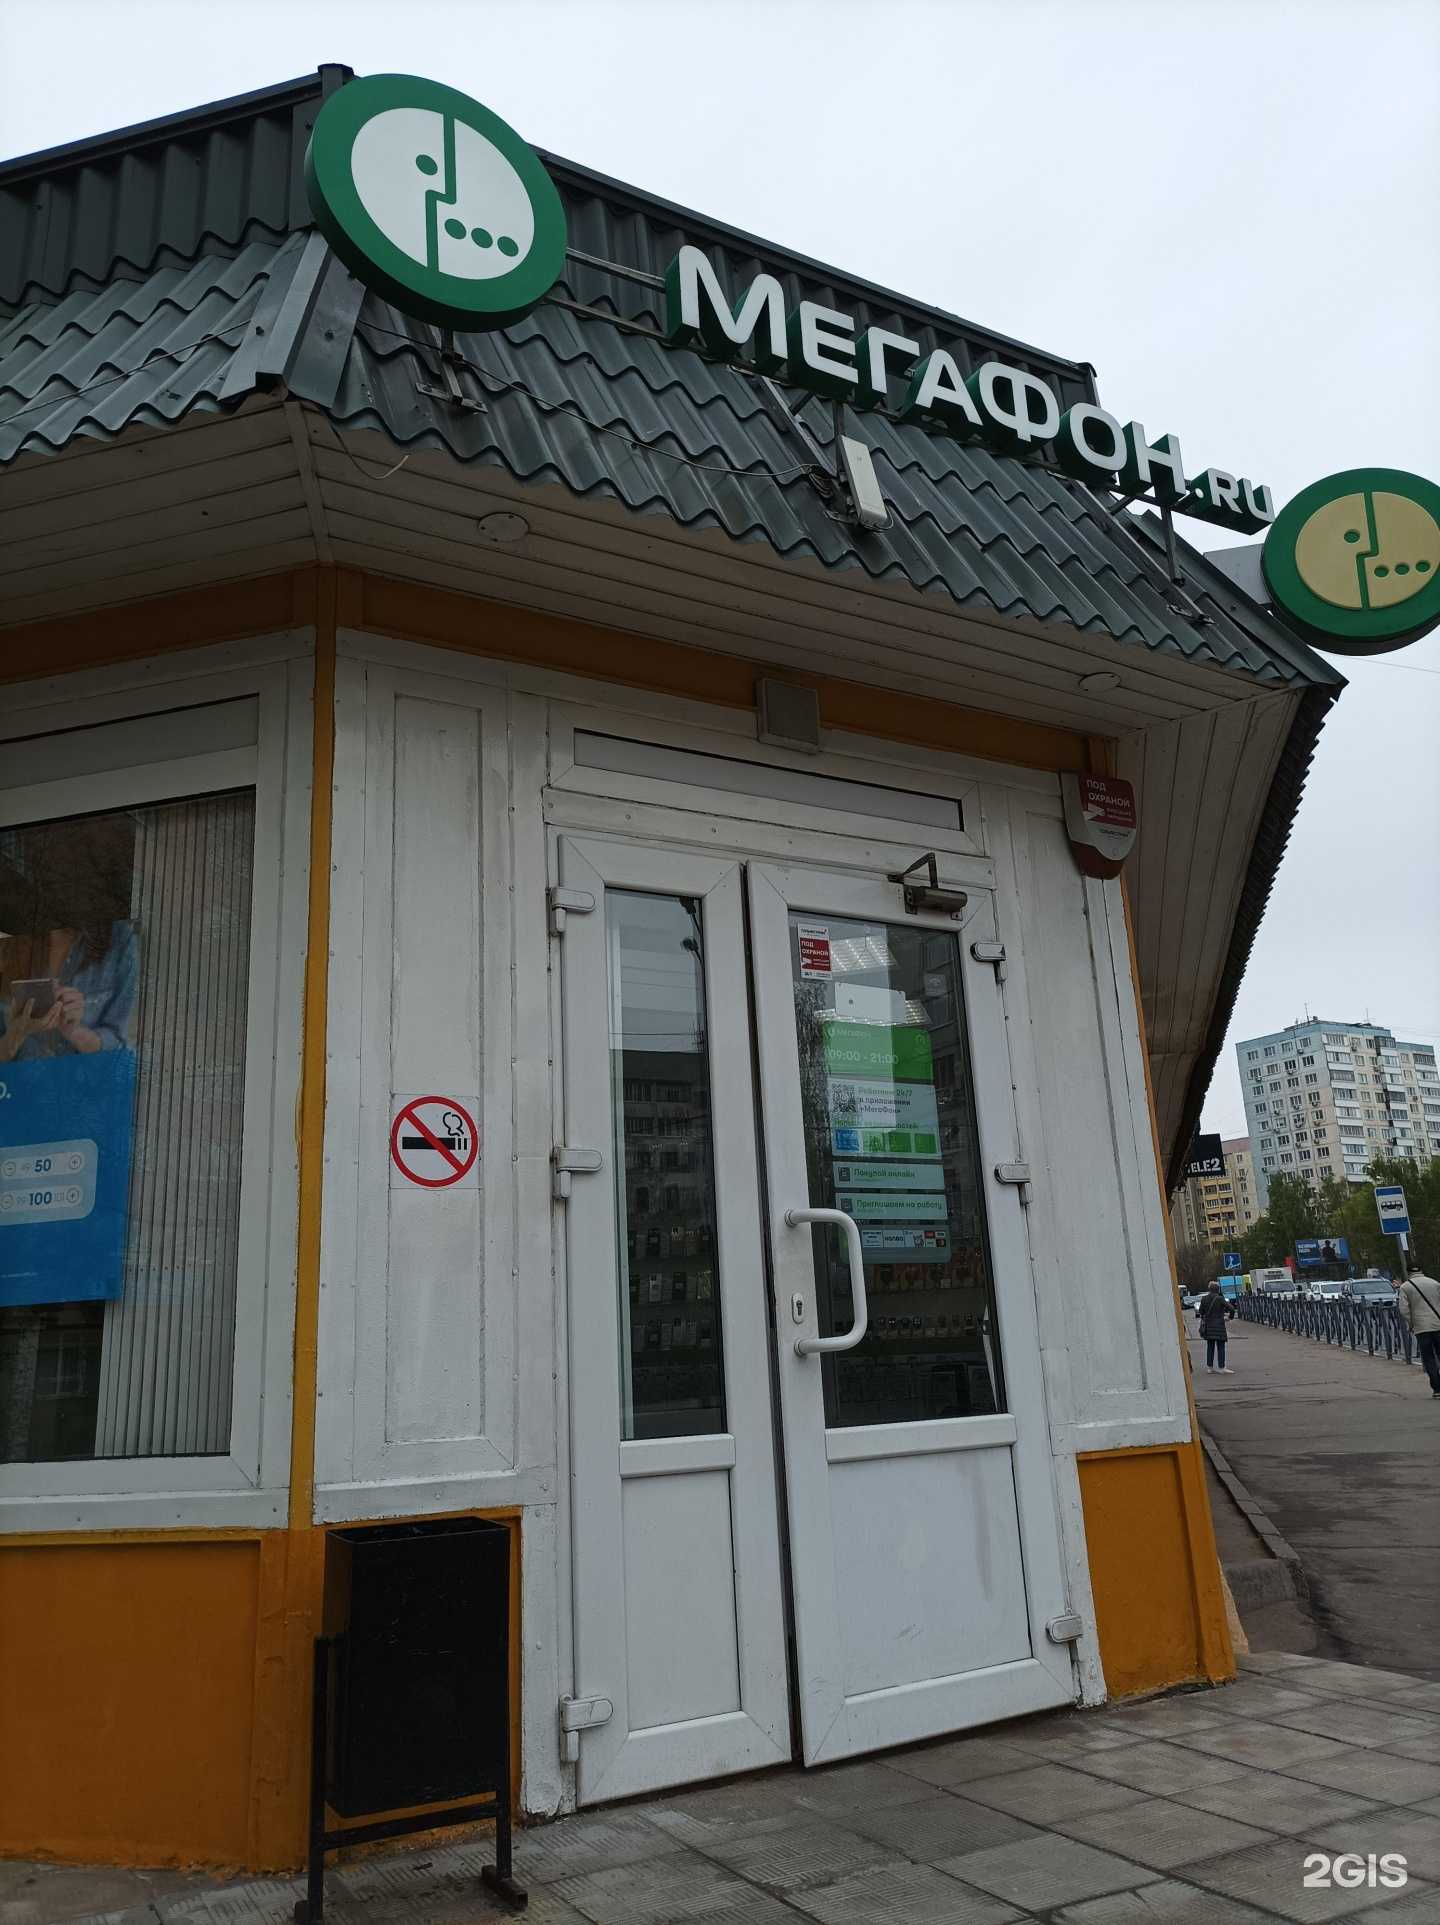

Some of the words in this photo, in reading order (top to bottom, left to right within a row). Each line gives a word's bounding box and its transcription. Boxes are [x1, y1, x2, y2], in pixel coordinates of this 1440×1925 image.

[1086, 779, 1106, 792] ПОД
[1088, 792, 1131, 808] ОХРАНОЙ
[34, 1159, 52, 1173] 50
[29, 1191, 53, 1206] 100
